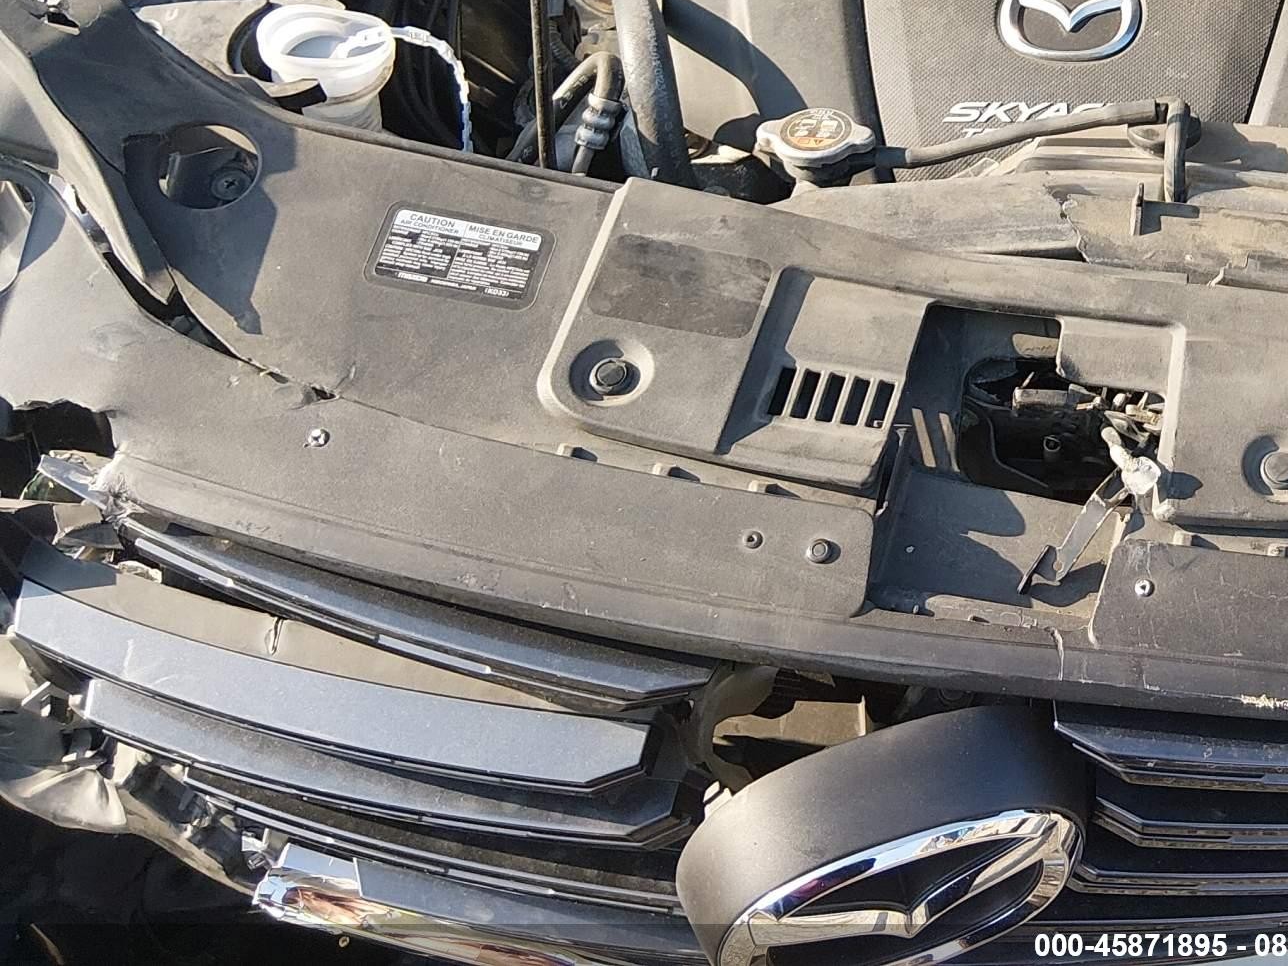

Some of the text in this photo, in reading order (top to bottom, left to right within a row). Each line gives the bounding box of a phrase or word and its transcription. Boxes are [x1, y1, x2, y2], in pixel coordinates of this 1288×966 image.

[410, 213, 456, 228] CAUTION
[413, 221, 460, 235] CONDITIONER
[468, 224, 539, 244] MISE EN GARDE
